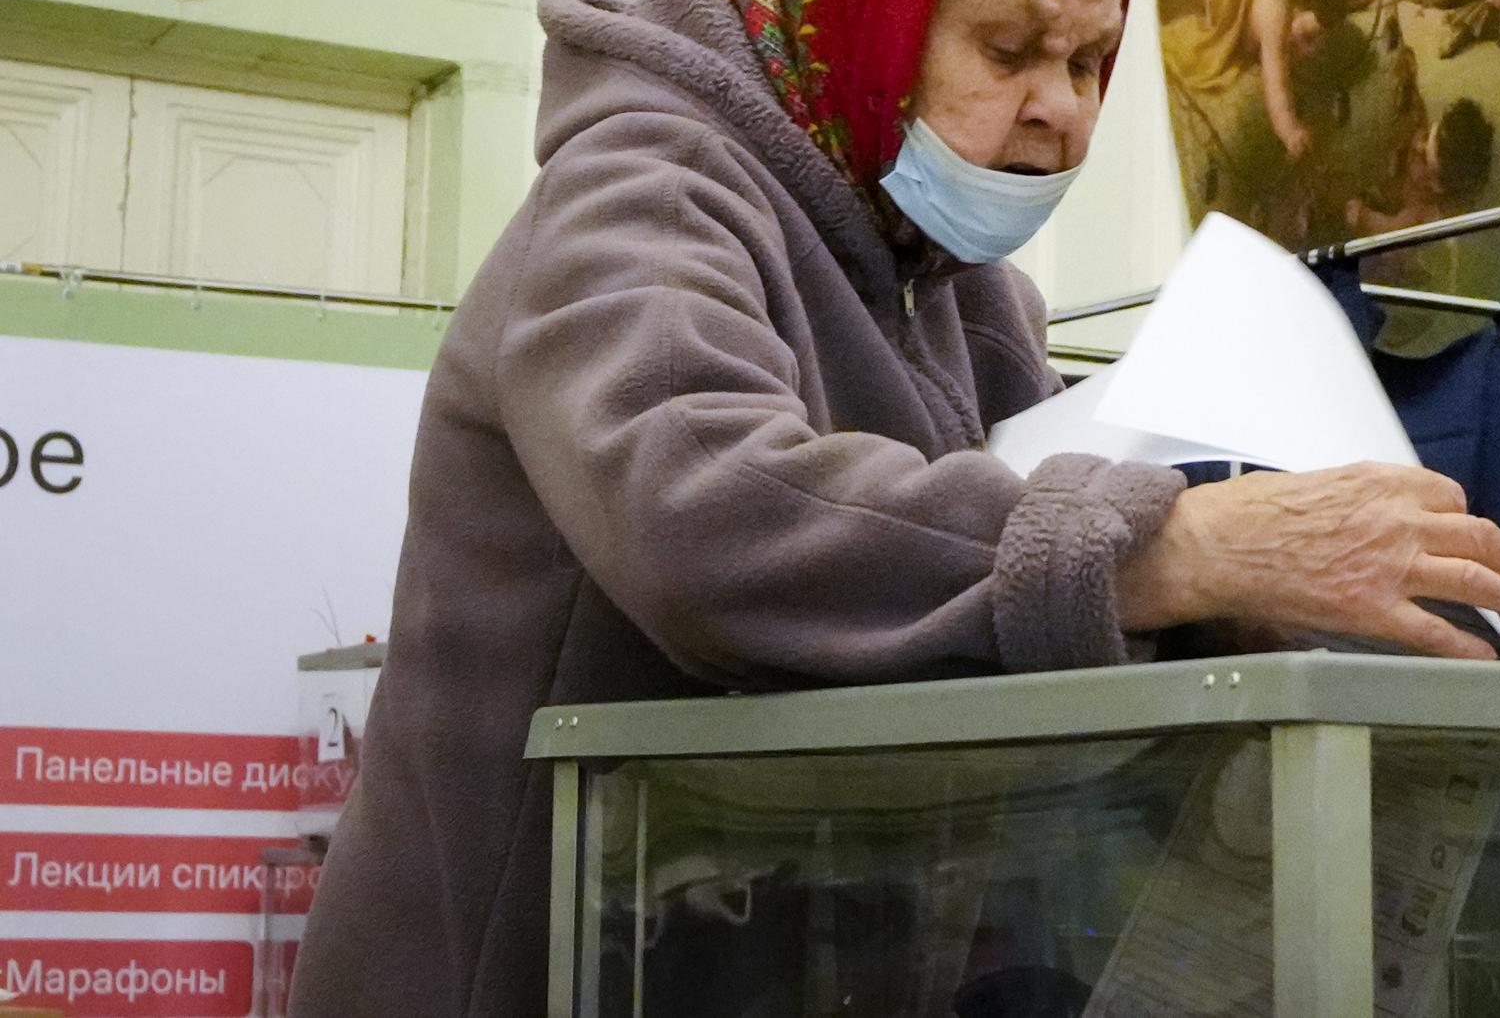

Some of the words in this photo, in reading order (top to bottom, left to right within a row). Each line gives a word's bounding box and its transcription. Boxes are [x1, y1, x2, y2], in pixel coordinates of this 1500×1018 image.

[16, 746, 234, 786] Панельные
[9, 851, 160, 893] Лекции
[7, 958, 225, 1003] Марафоны
